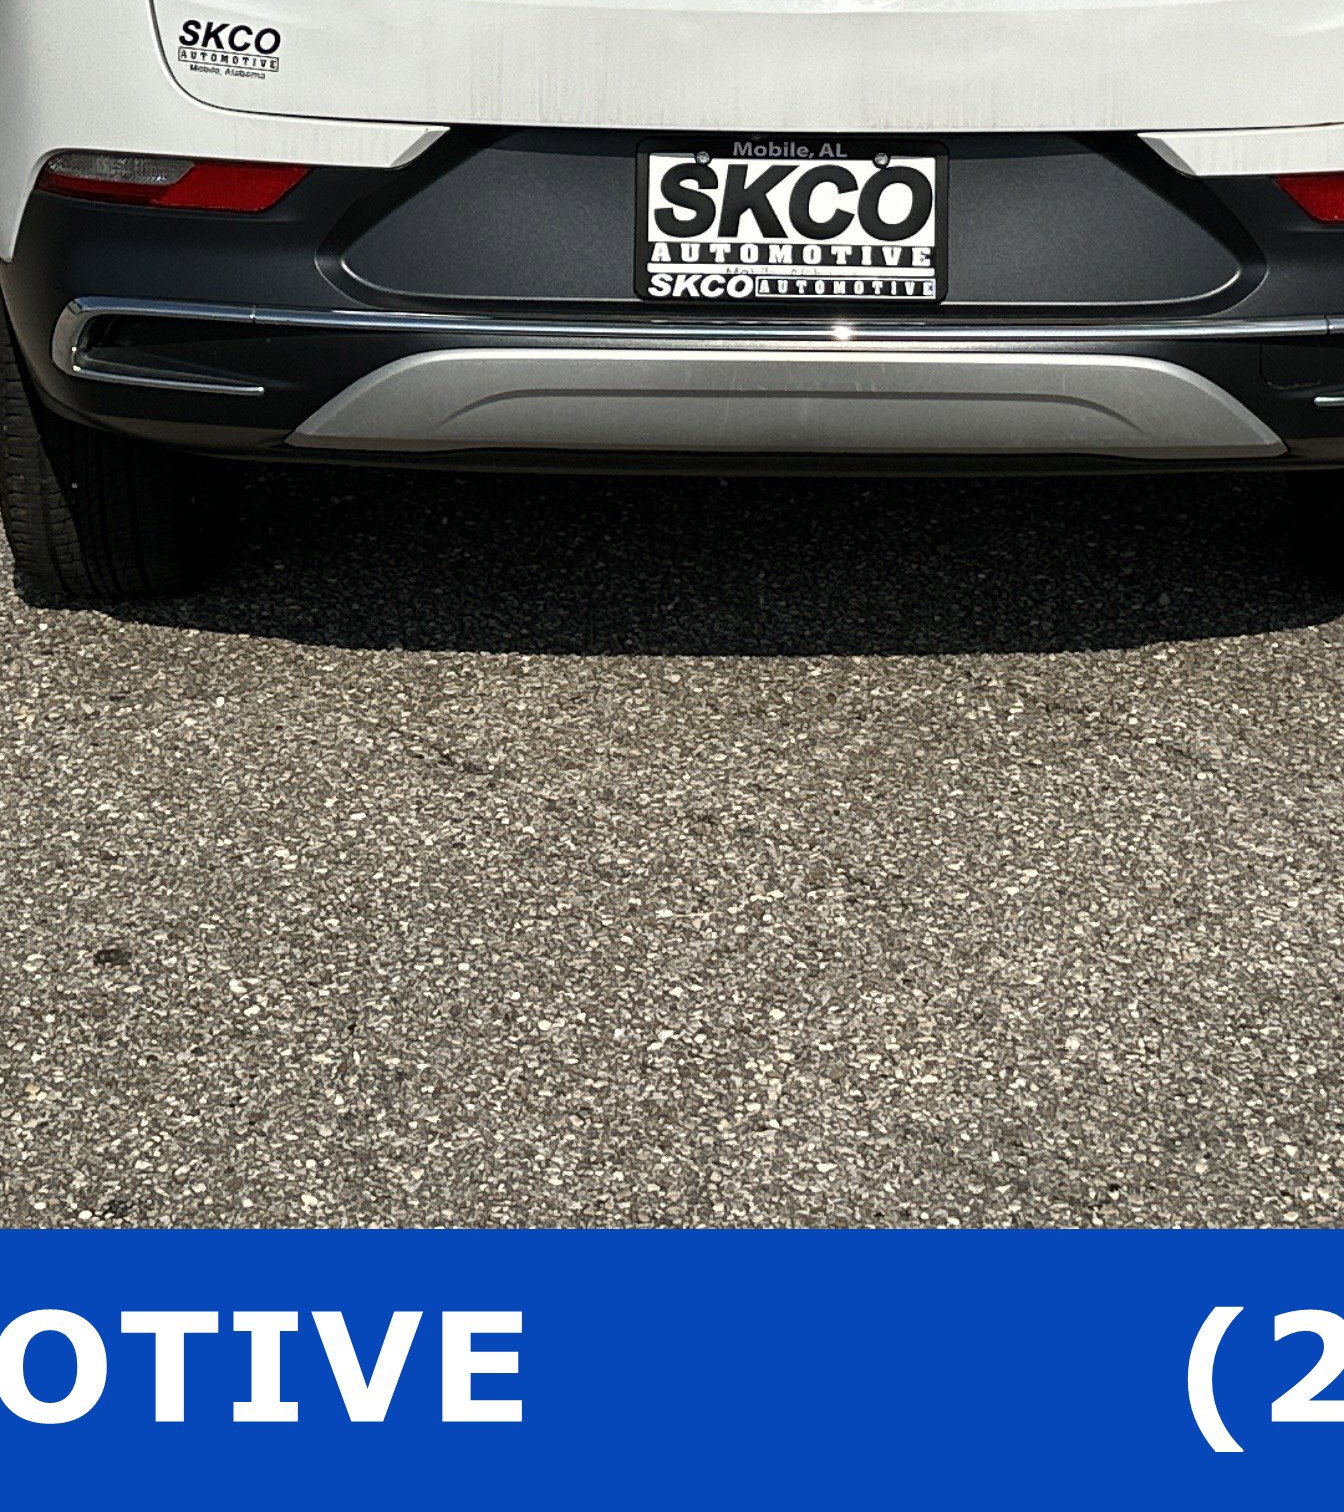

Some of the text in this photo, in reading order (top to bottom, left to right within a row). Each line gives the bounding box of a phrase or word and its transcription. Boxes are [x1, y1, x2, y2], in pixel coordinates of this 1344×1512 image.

[178, 19, 281, 55] SKCO
[180, 49, 277, 69] AUTOMOTIVE
[733, 141, 848, 159] Mobile, AL
[653, 162, 934, 242] SKCO
[651, 242, 931, 267] AUTOMOTIVE
[648, 274, 935, 298] SKCO AUTOMOTIVE
